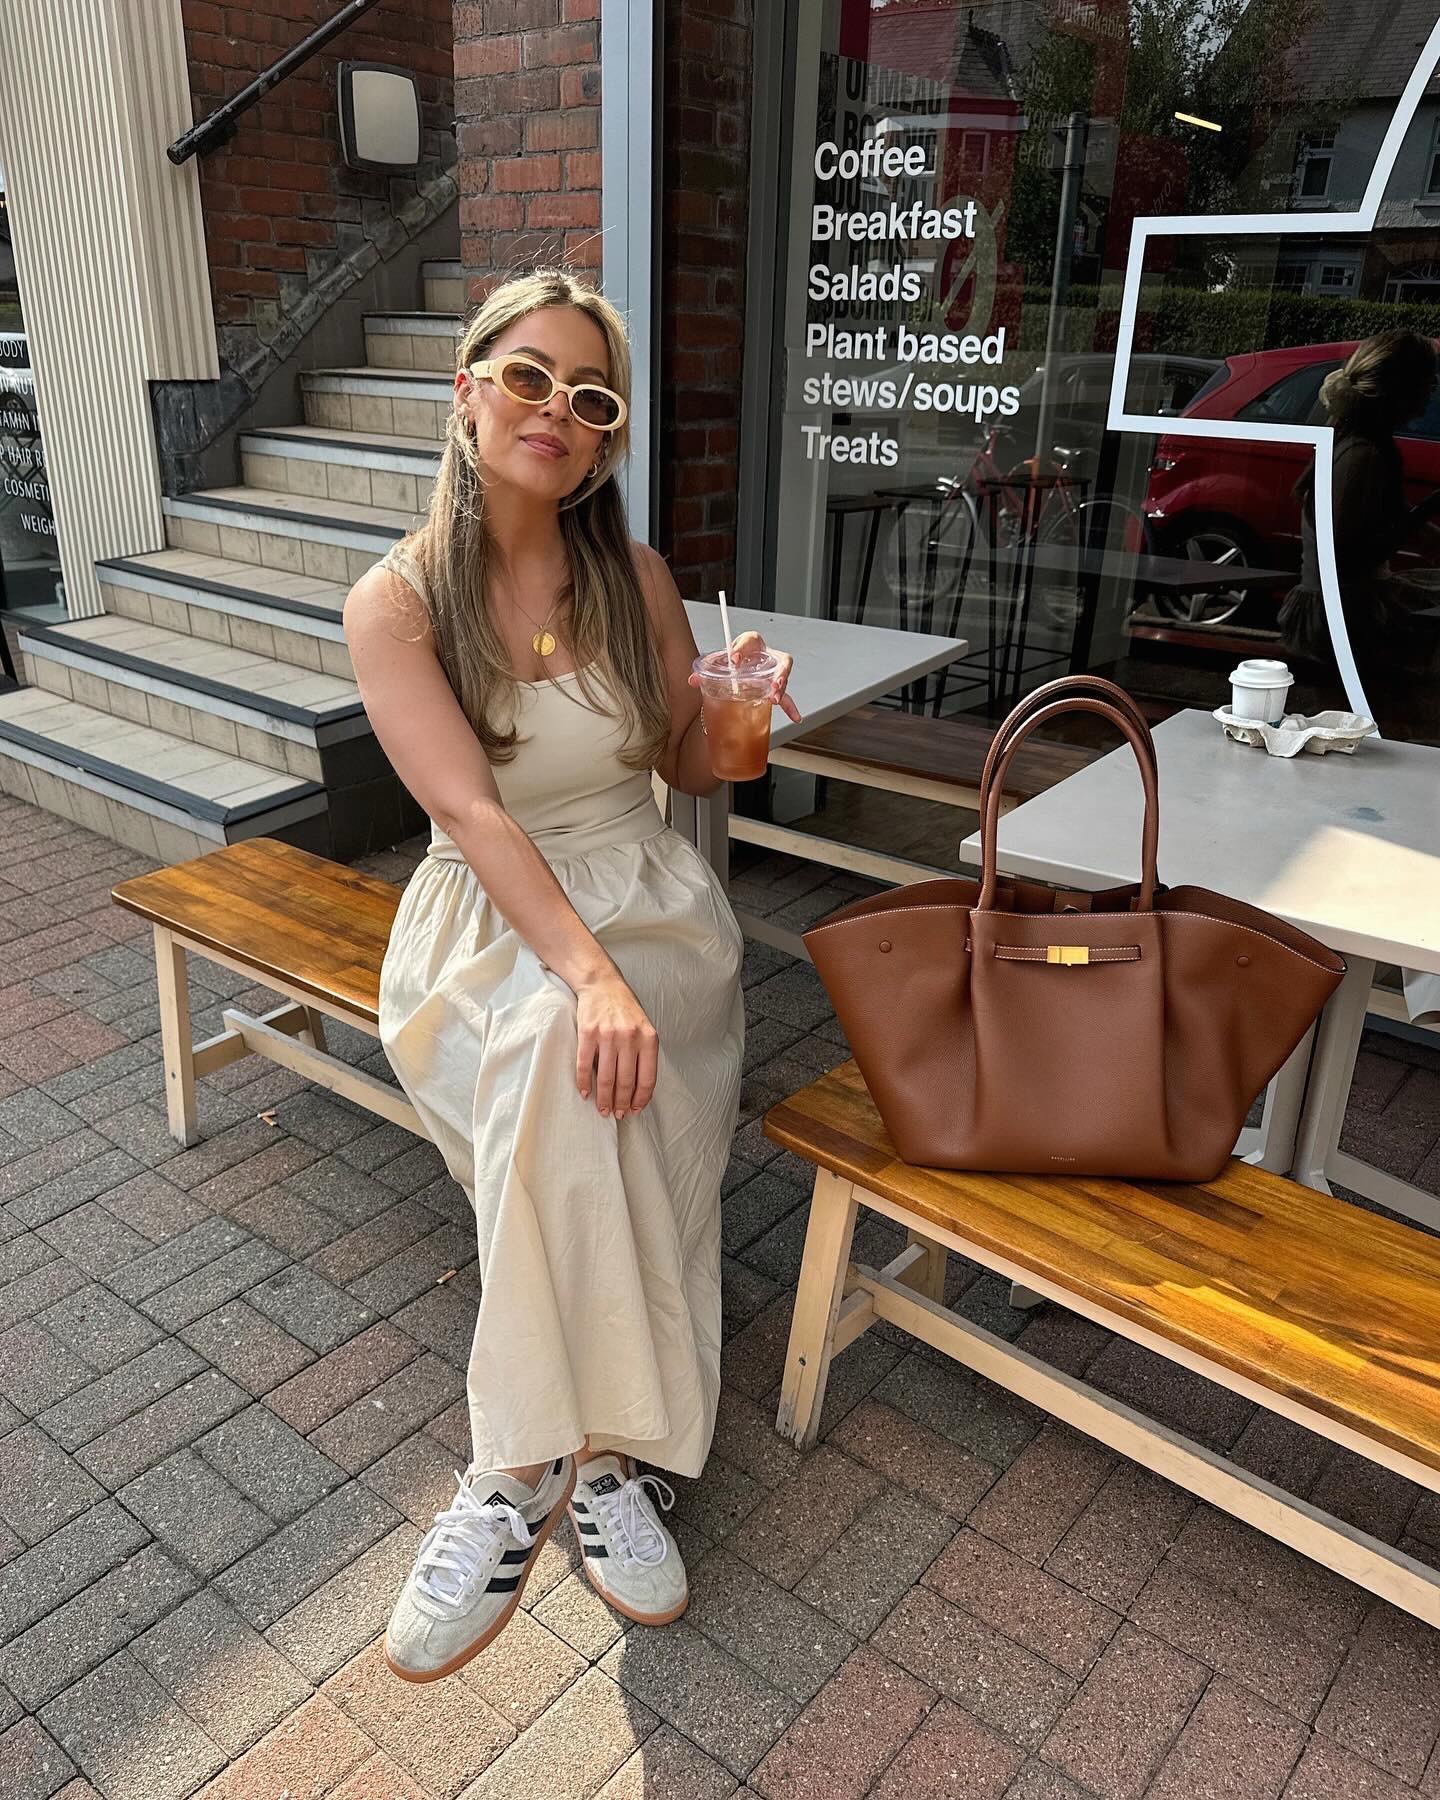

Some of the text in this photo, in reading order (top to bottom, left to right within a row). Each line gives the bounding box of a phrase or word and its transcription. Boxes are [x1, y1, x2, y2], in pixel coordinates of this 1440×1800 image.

[814, 138, 926, 181] Coffee
[811, 200, 978, 242] Breakfast
[807, 263, 921, 302] Salads
[806, 323, 1006, 365] Plant based
[802, 371, 1021, 424] stews/soups
[7, 445, 33, 465] HAIR
[800, 425, 899, 467] Treats
[4, 477, 50, 502] COSMETI
[20, 512, 57, 536] WEIGH
